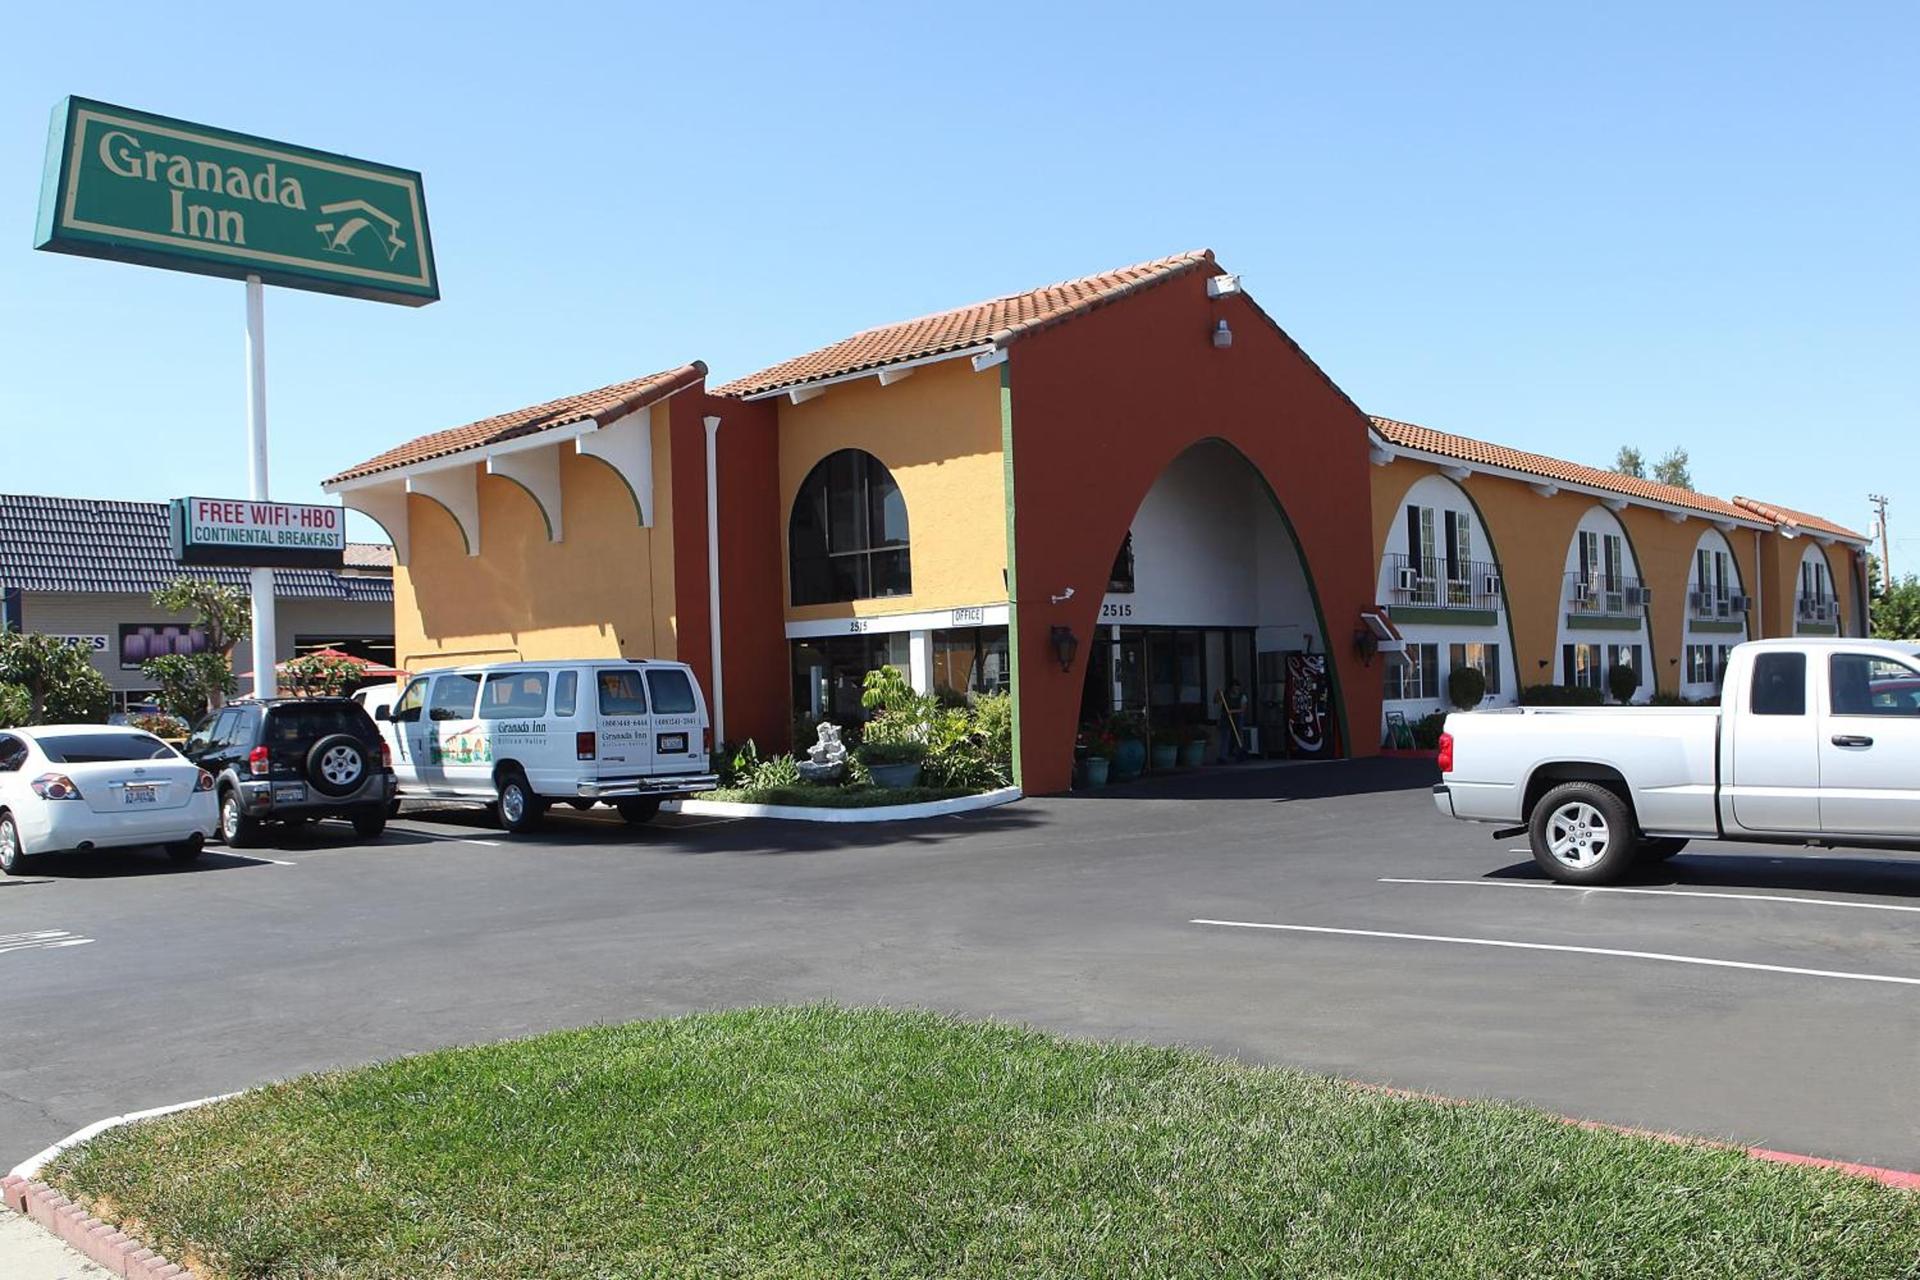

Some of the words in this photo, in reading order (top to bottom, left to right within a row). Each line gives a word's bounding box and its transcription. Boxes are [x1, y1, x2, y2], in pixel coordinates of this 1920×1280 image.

[100, 131, 306, 210] Granada
[170, 189, 246, 244] Inn
[199, 502, 245, 524] FREE
[301, 508, 335, 529] HBO
[195, 526, 274, 544] CONTINENTAL
[278, 530, 340, 547] BREAKFAST
[955, 609, 980, 621] OFFICE
[1103, 604, 1132, 616] 2515
[498, 721, 529, 733] Granada
[532, 720, 546, 732] Inn
